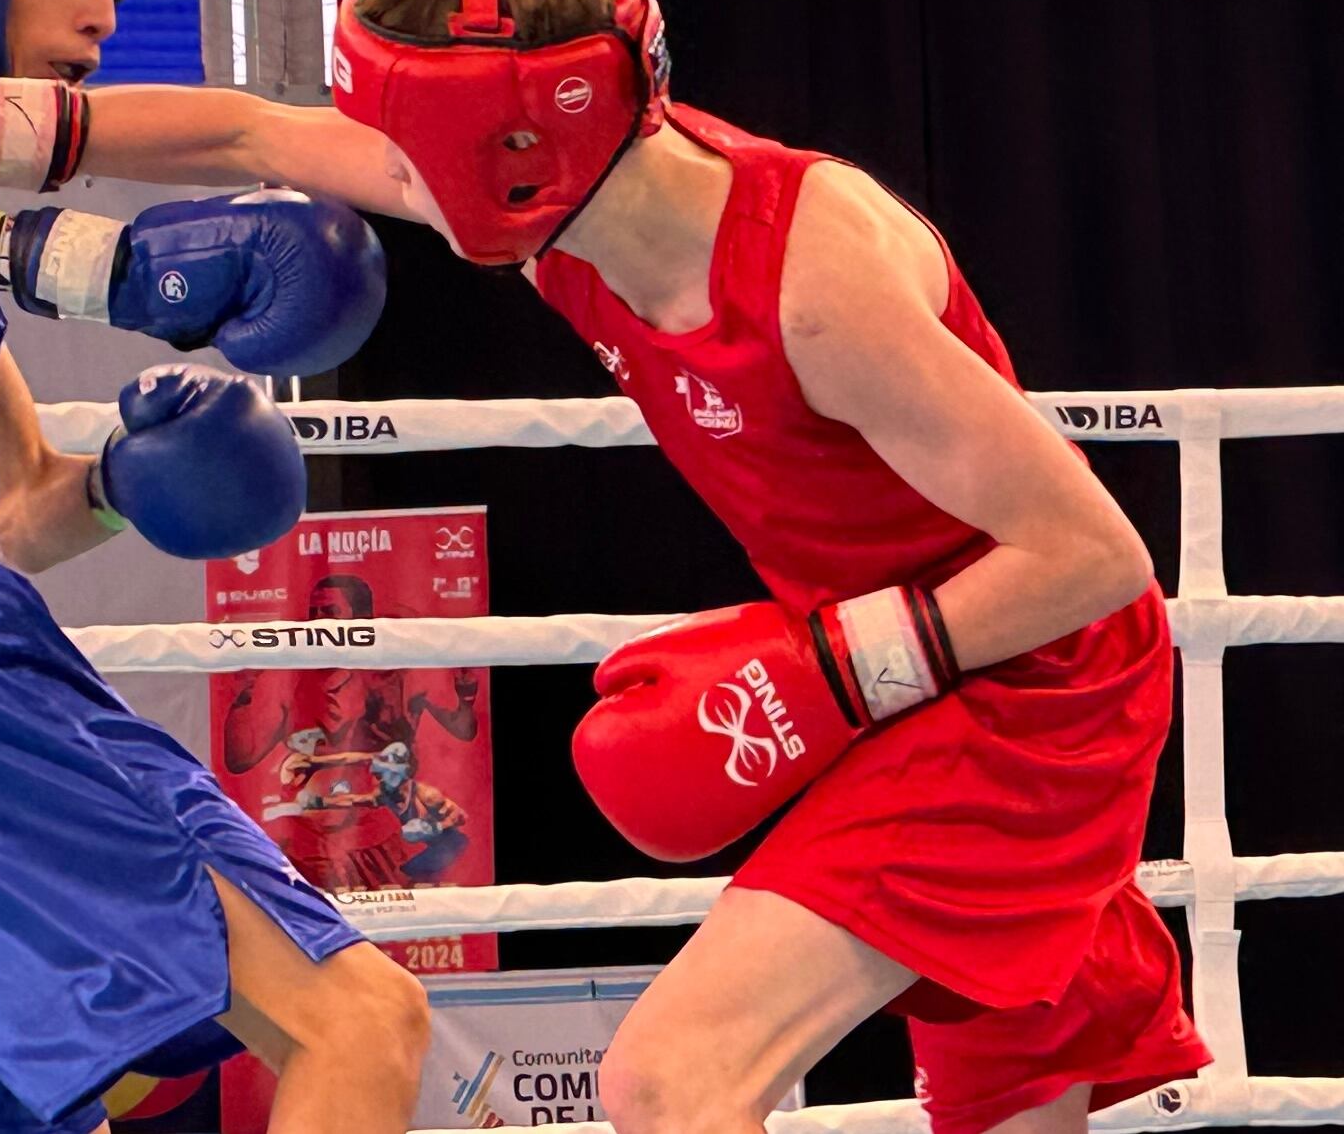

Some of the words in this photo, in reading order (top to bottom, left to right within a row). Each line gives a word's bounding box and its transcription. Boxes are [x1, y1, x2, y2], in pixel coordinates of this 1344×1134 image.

[333, 416, 398, 440] IBA
[1104, 404, 1163, 430] IBA
[299, 532, 323, 556] LA
[252, 626, 375, 647] STING
[736, 658, 807, 760] STING
[406, 943, 464, 969] 2024
[514, 1070, 599, 1102] COM
